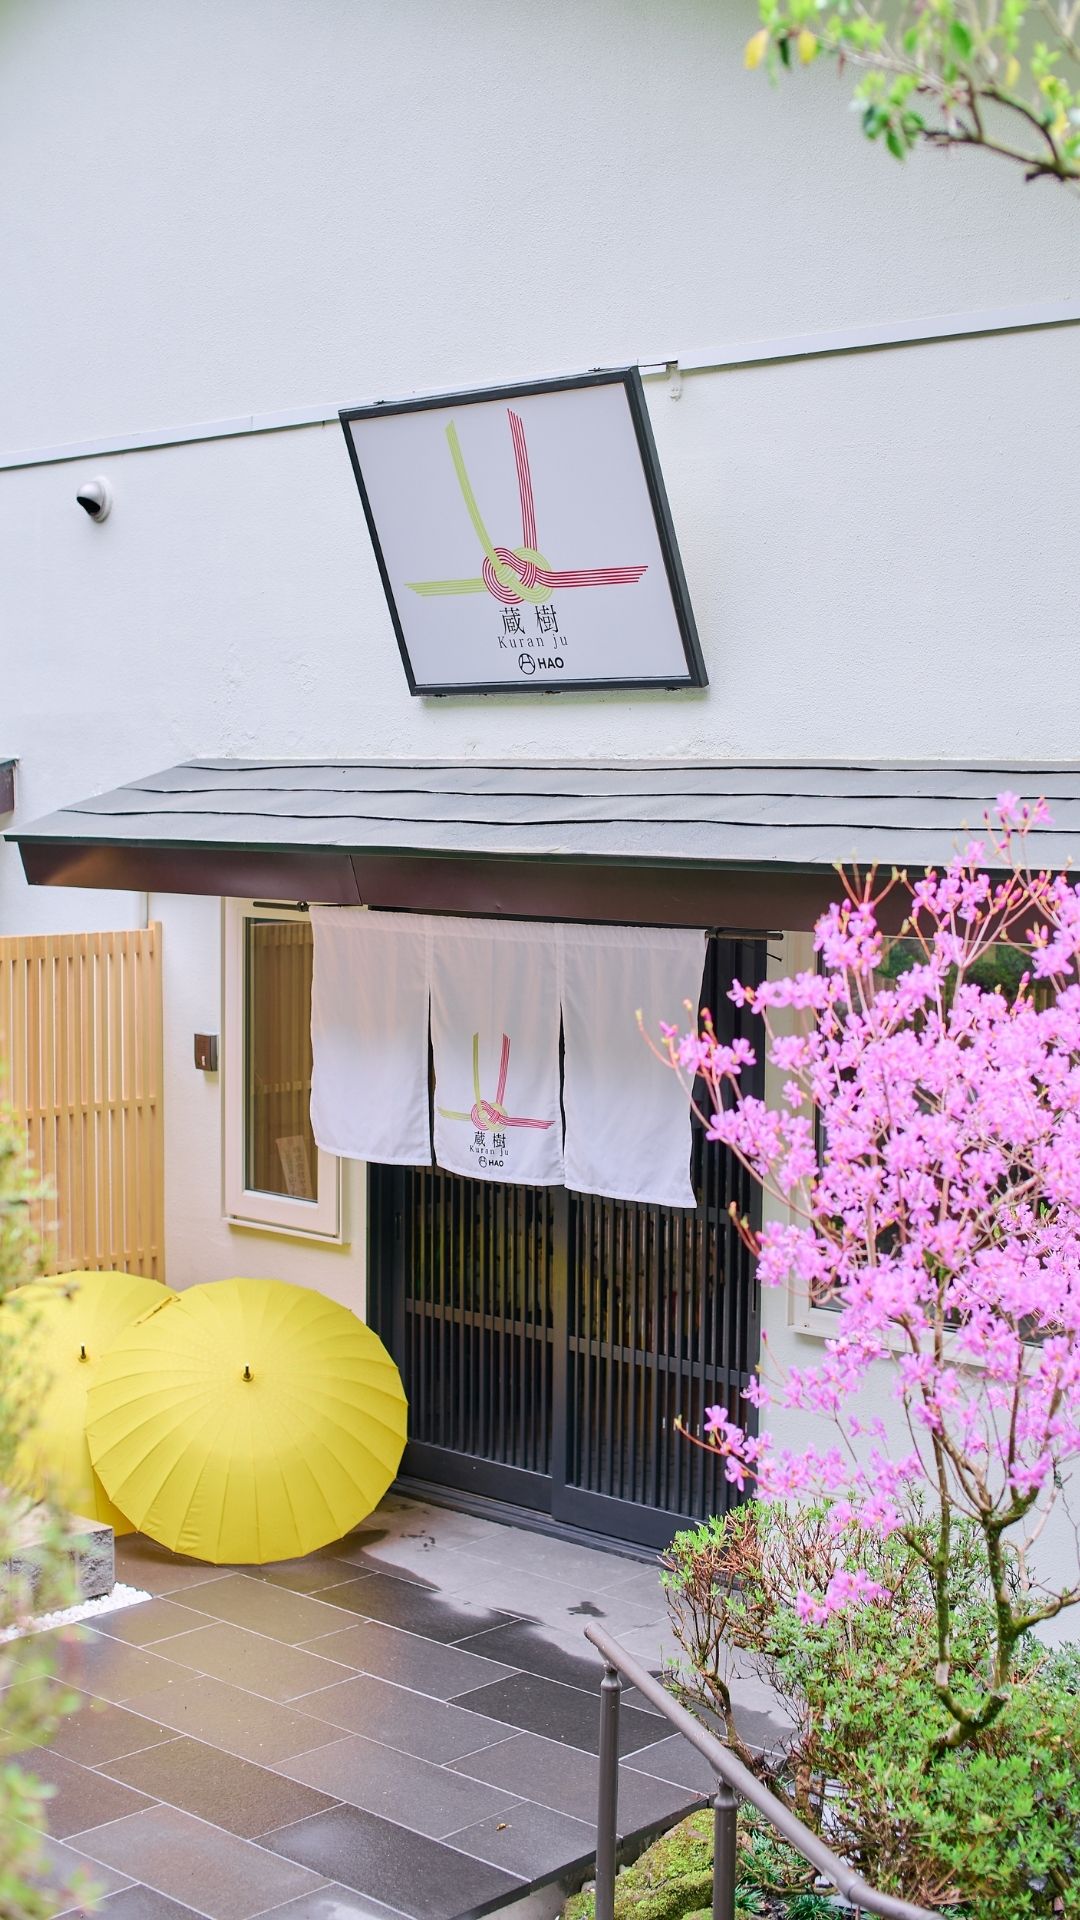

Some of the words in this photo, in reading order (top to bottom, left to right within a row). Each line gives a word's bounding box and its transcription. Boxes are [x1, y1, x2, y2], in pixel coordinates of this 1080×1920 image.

[499, 605, 559, 634] 蔵樹
[497, 635, 545, 649] Kuran
[552, 634, 568, 649] ju
[537, 656, 565, 669] HAO
[474, 1131, 506, 1148] 蔵樹
[469, 1145, 495, 1155] Kuran
[488, 1159, 504, 1167] HAO
